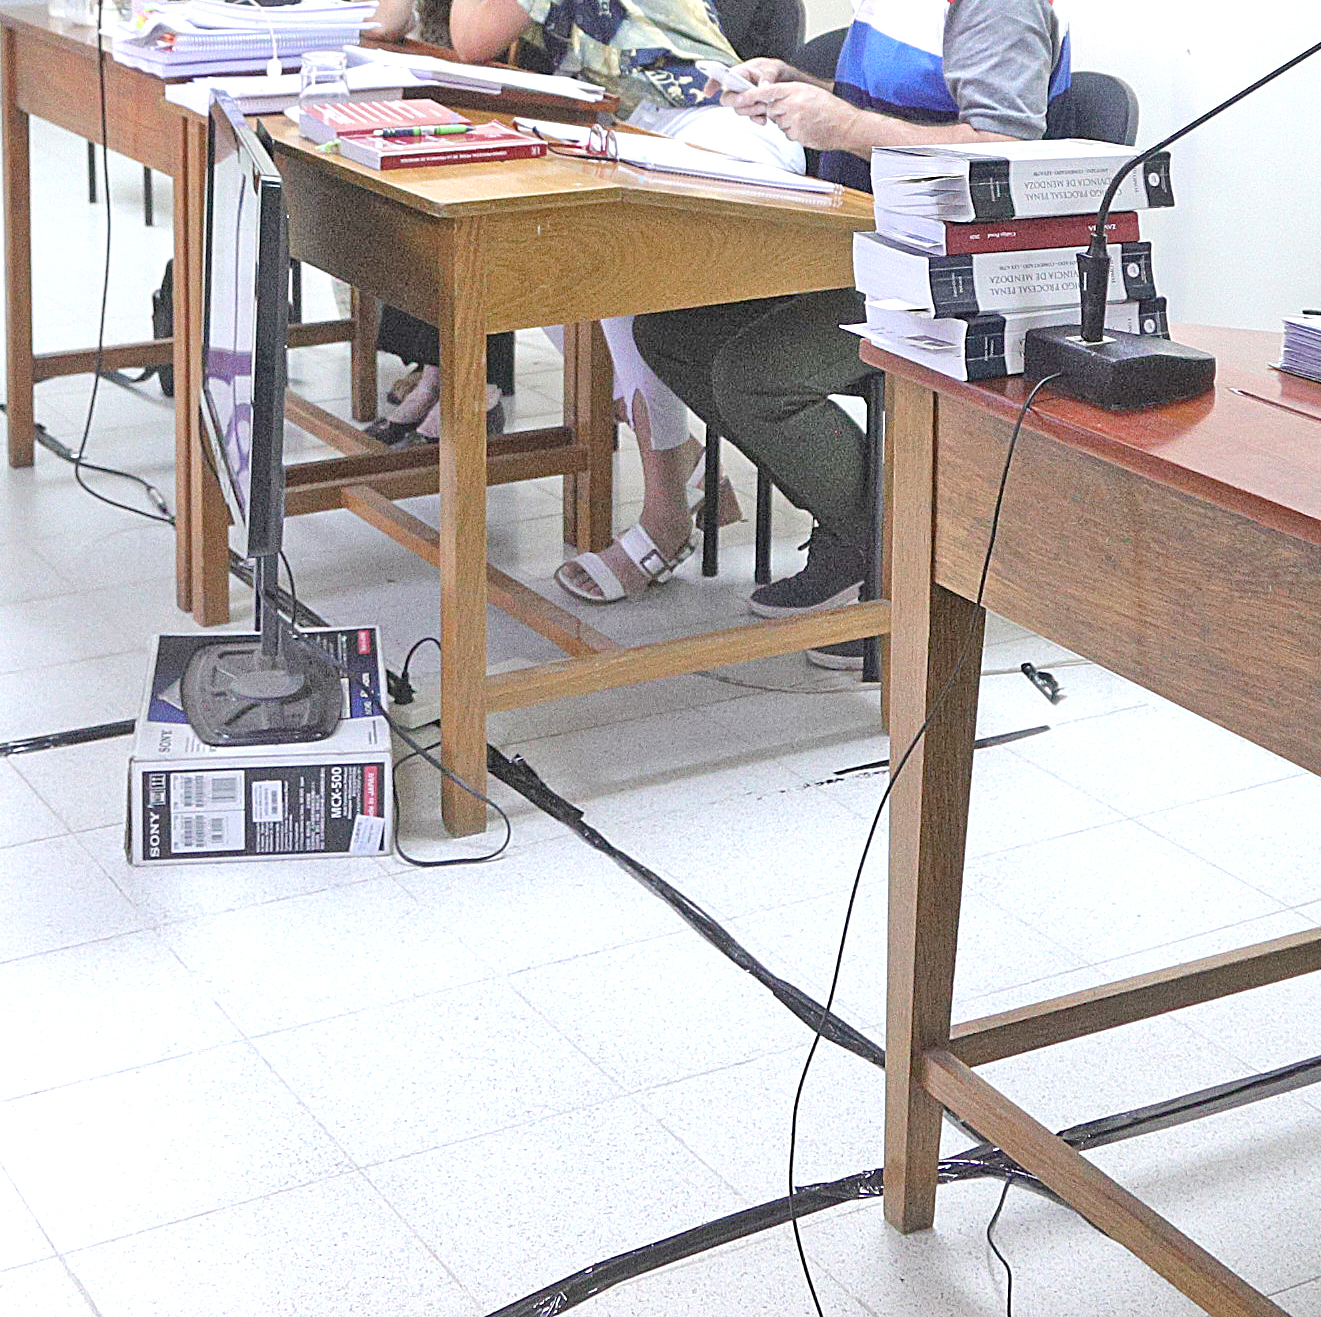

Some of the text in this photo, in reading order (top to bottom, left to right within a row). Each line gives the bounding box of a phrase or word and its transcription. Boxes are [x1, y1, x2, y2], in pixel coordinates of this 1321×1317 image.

[1024, 176, 1113, 190] OVINCIA DE MENDOZA
[1025, 188, 1122, 202] CIGO PROCESAL PENAL
[989, 270, 1080, 284] VINCIA DE MENDOZA
[990, 286, 1016, 296] PENAL
[1019, 283, 1059, 294] PROCESAL
[159, 729, 172, 753] SONY
[367, 772, 375, 797] JAPAN
[331, 766, 342, 819] MCX-500
[149, 811, 160, 858] SONY
